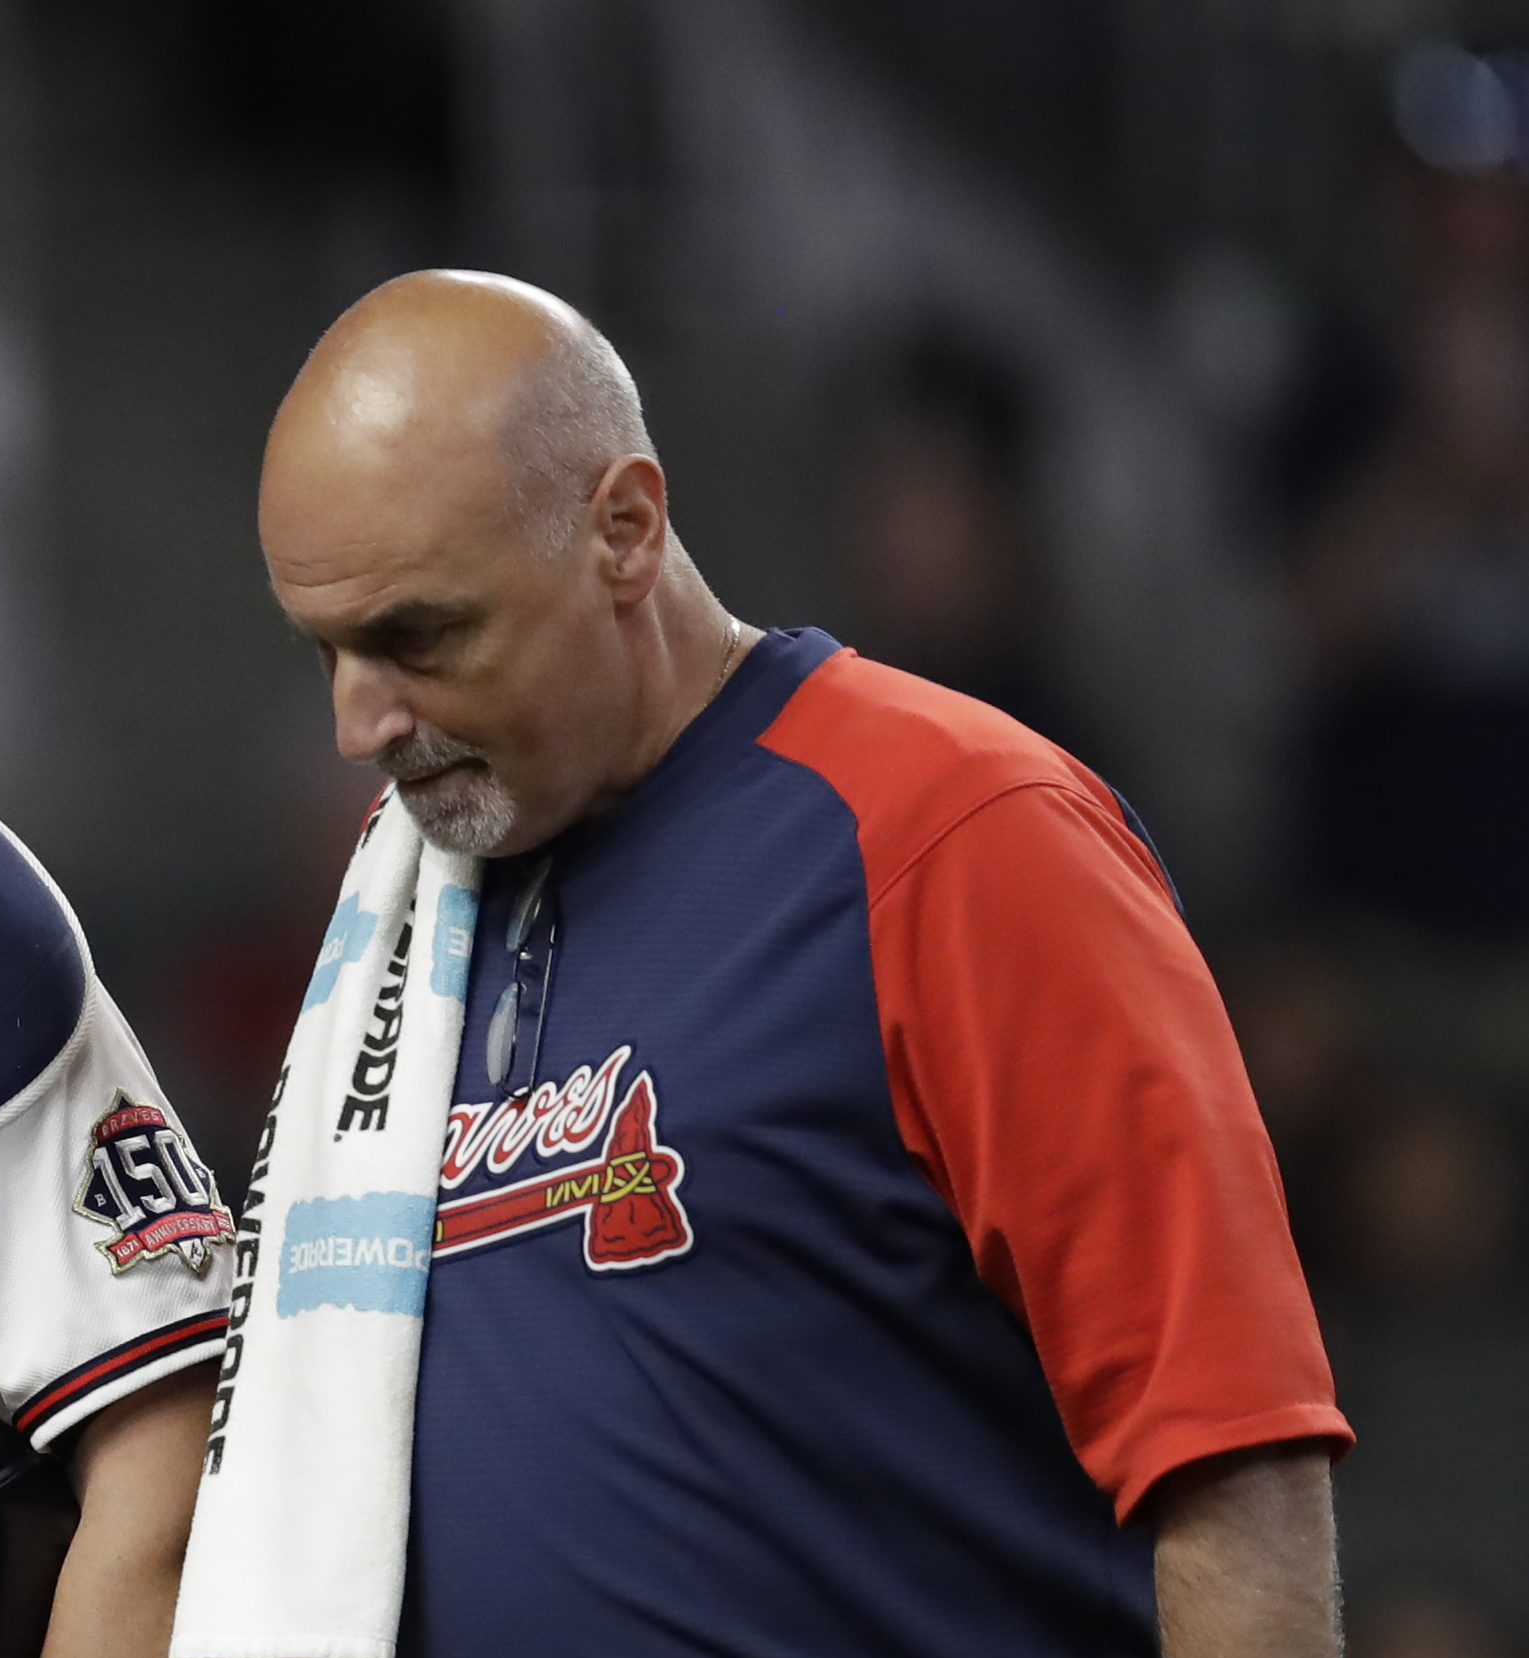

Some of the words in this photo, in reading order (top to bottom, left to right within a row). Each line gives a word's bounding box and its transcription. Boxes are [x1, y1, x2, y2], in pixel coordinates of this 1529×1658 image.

[101, 1110, 161, 1137] BRAVES
[91, 1129, 210, 1232] 150
[145, 1216, 216, 1247] ANNIVERSARY
[288, 1235, 430, 1275] POWERADE
